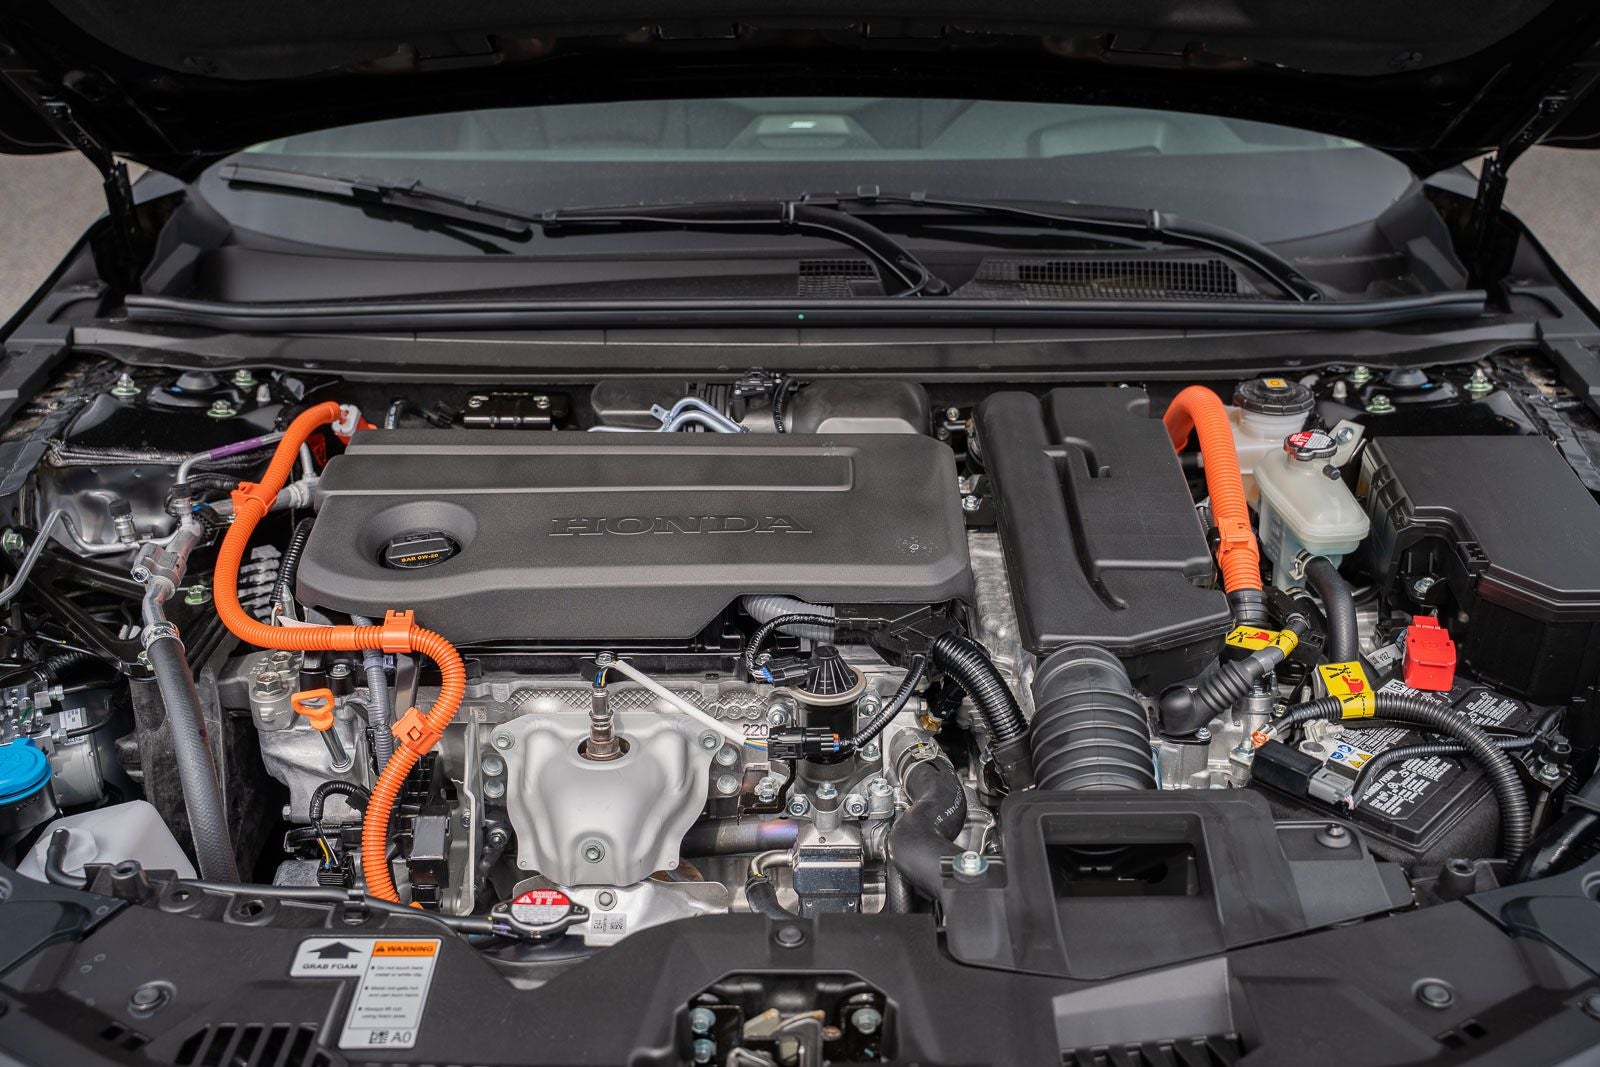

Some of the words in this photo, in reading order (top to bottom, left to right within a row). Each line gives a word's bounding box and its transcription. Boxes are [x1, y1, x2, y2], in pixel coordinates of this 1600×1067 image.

[549, 516, 812, 536] HONDA
[417, 553, 439, 561] 0W-20
[742, 723, 769, 737] 220
[387, 945, 434, 953] WARNING
[390, 1031, 412, 1043] A0
